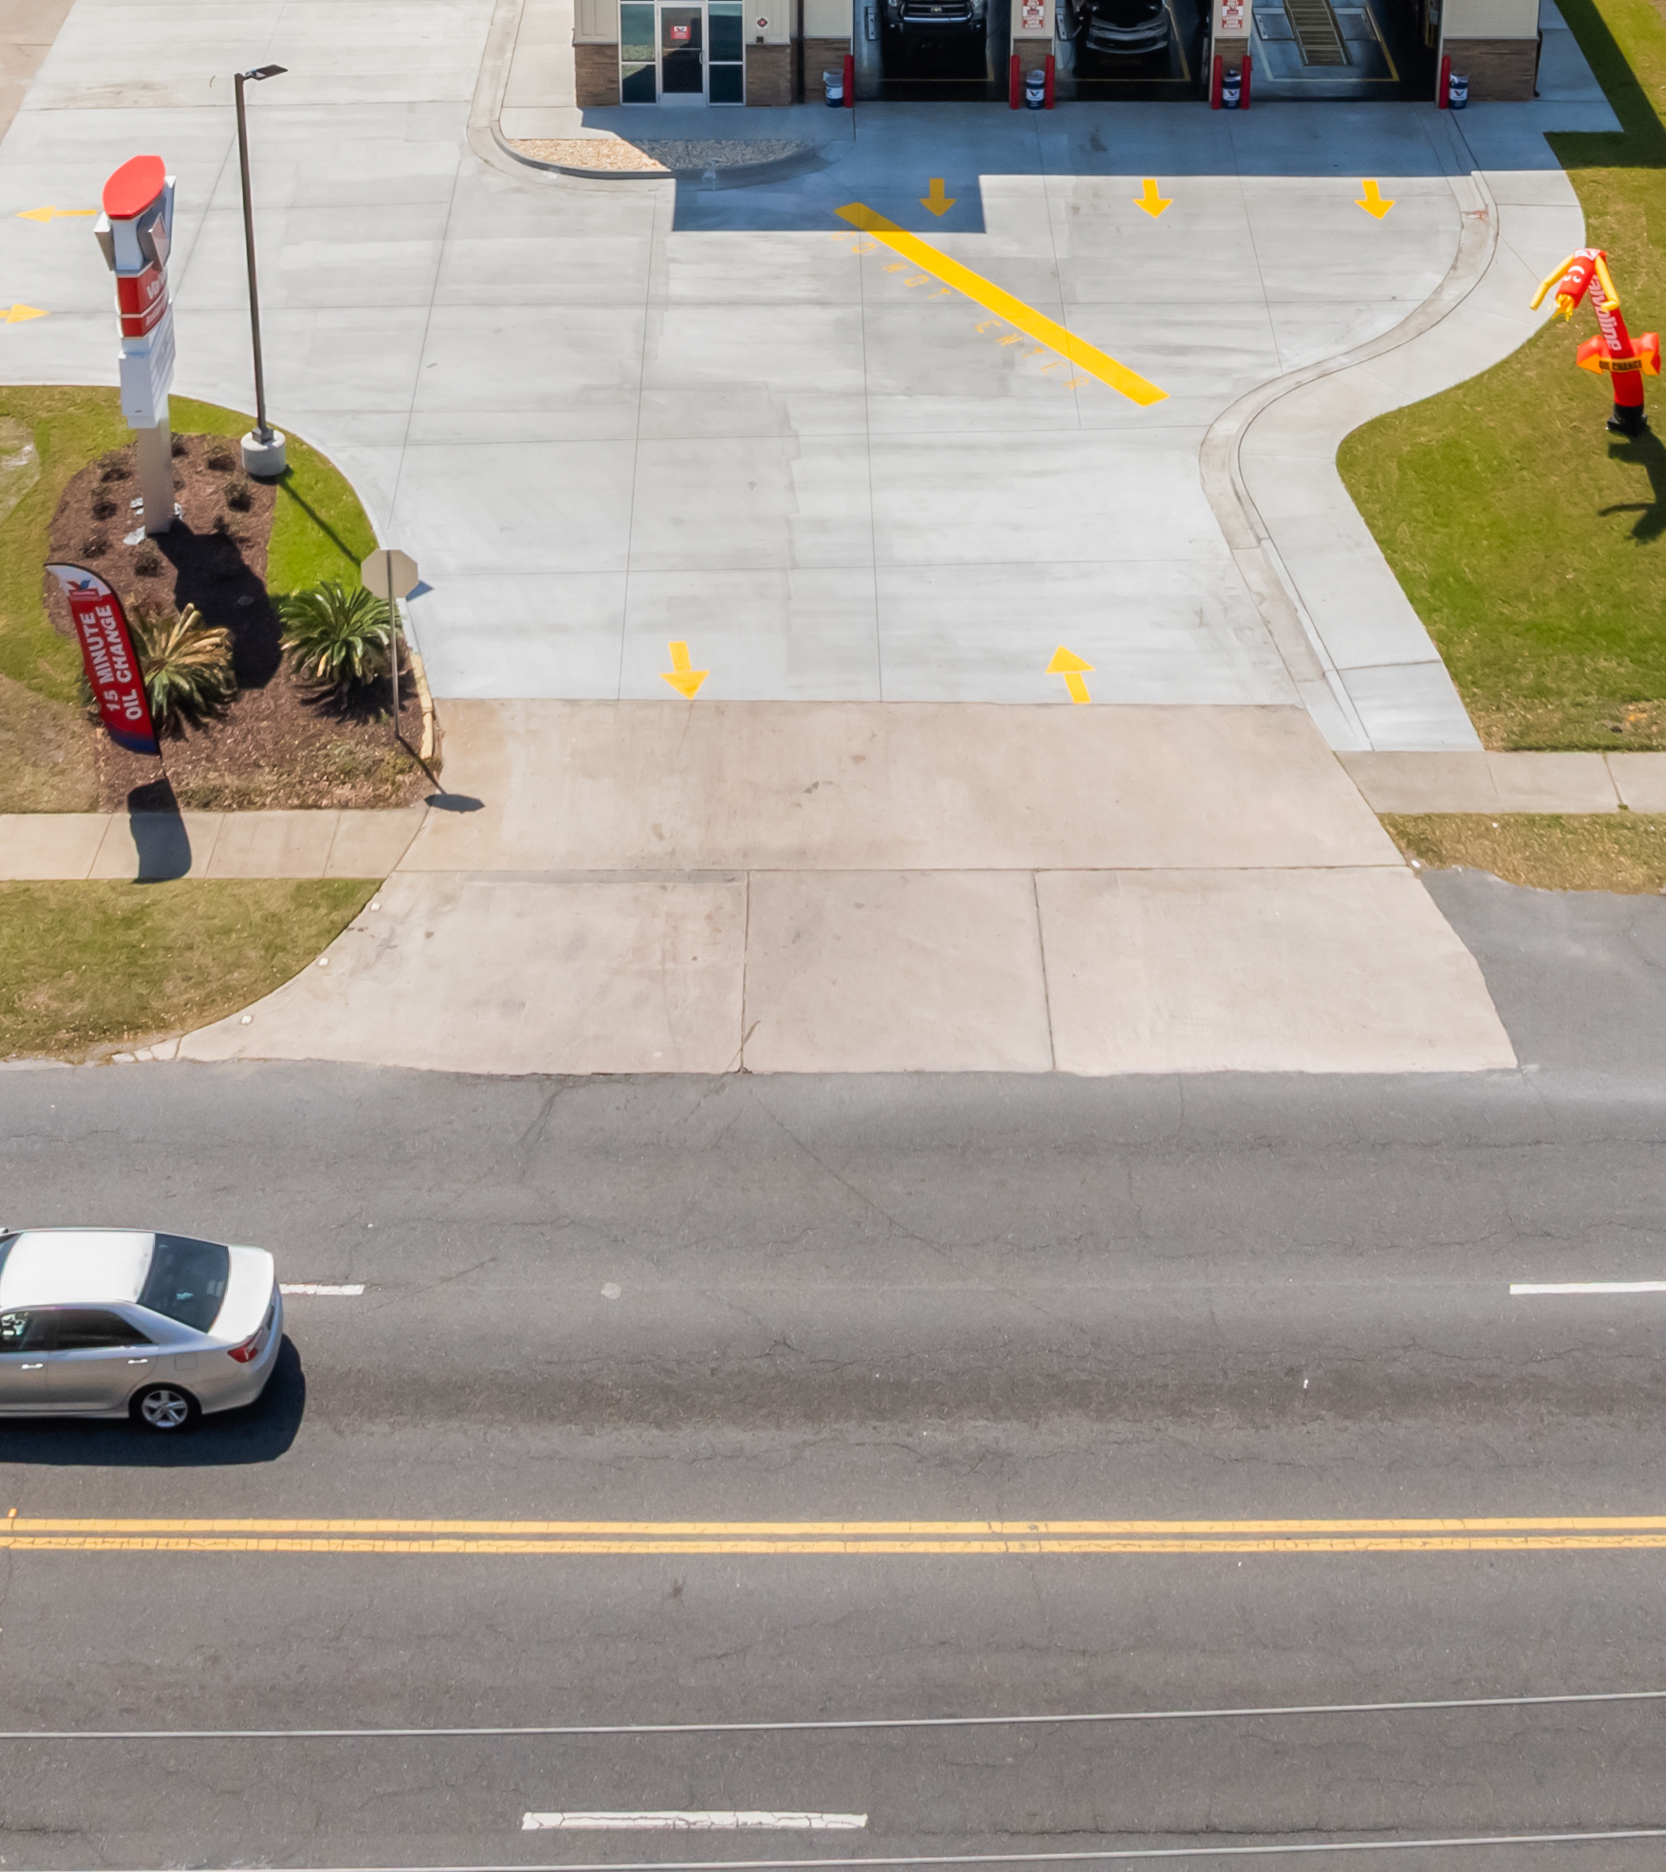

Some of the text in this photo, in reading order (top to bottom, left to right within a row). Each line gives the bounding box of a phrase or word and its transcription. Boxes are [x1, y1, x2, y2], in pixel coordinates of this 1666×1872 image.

[882, 261, 952, 299] NOT
[973, 319, 1090, 390] ENTER
[1588, 274, 1622, 351] alvoline
[80, 612, 115, 684] MINUTE
[95, 605, 143, 720] OIL CHANGE
[104, 690, 121, 711] 15
